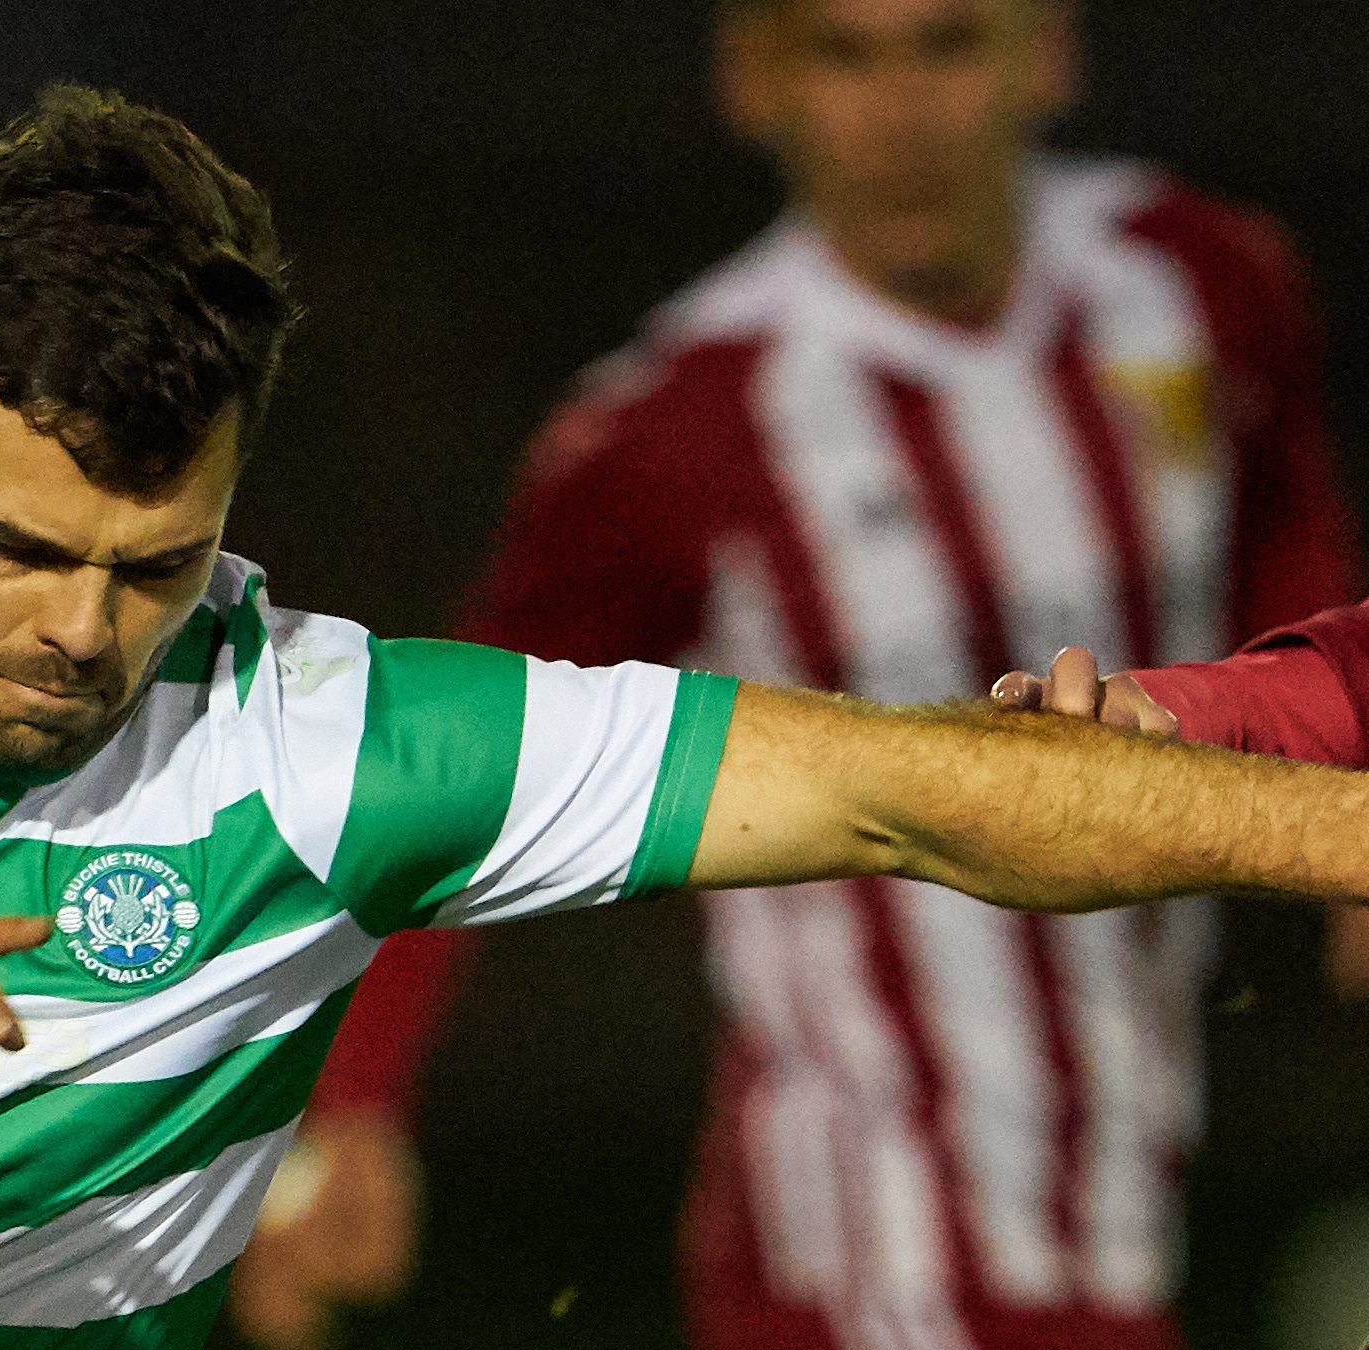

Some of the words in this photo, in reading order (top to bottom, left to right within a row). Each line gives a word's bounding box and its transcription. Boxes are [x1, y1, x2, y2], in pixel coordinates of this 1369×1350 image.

[62, 853, 120, 902] BUCKIE
[121, 851, 191, 897] THISTLE
[67, 938, 155, 983] FOOTBALL
[153, 935, 191, 975] CLUB
